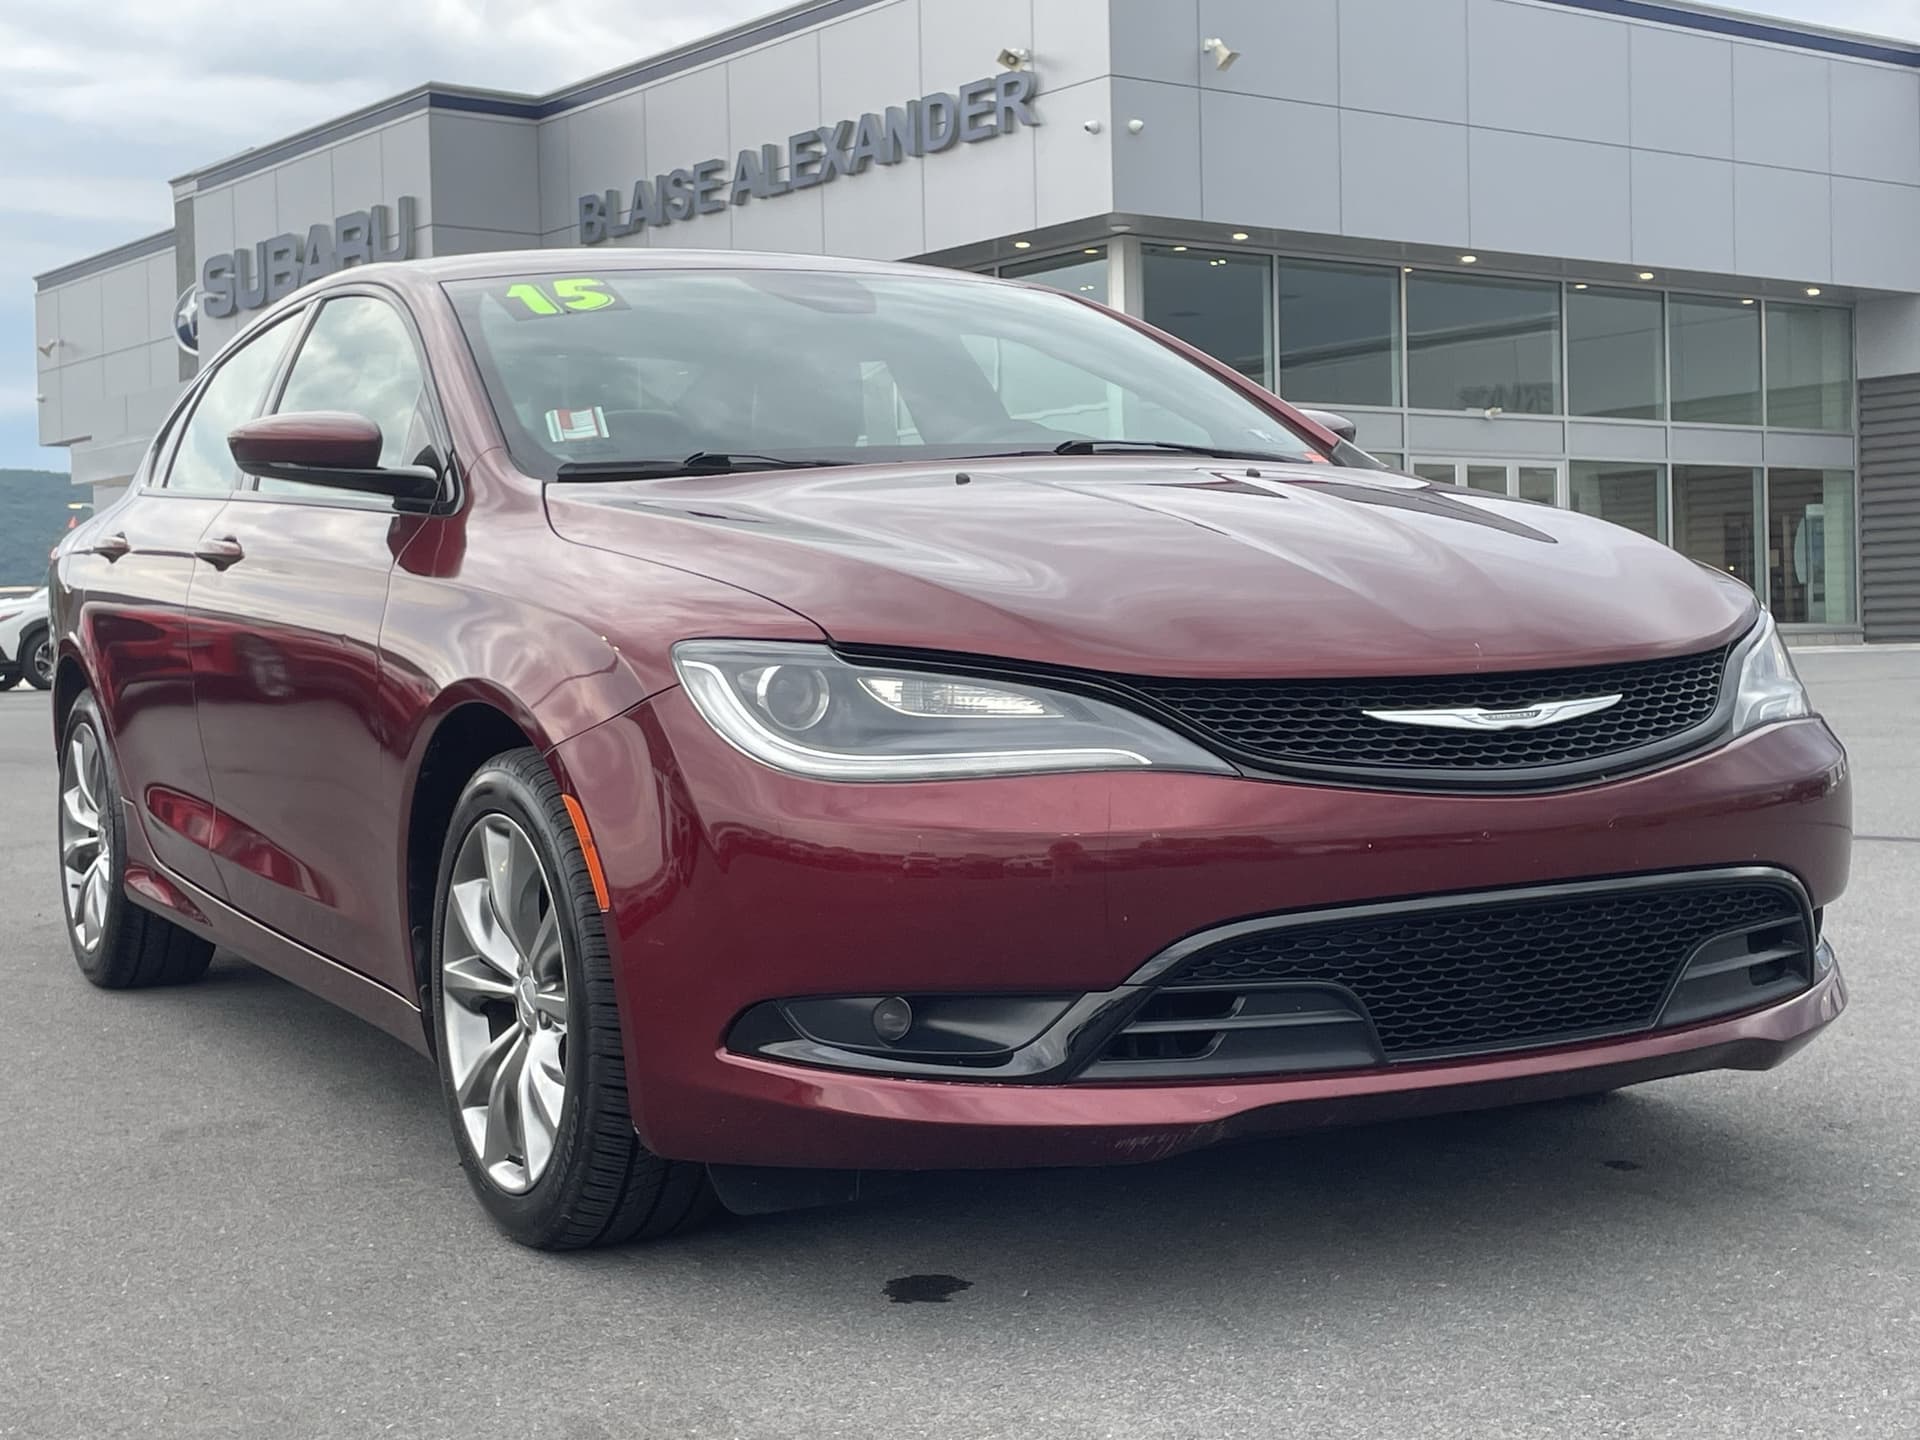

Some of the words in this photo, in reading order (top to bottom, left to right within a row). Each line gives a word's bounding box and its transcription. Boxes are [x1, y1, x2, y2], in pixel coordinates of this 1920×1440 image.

[578, 158, 726, 245] BLAISE
[729, 70, 1042, 206] ALEXANDER
[203, 196, 416, 318] SUBARU
[506, 279, 615, 315] 15
